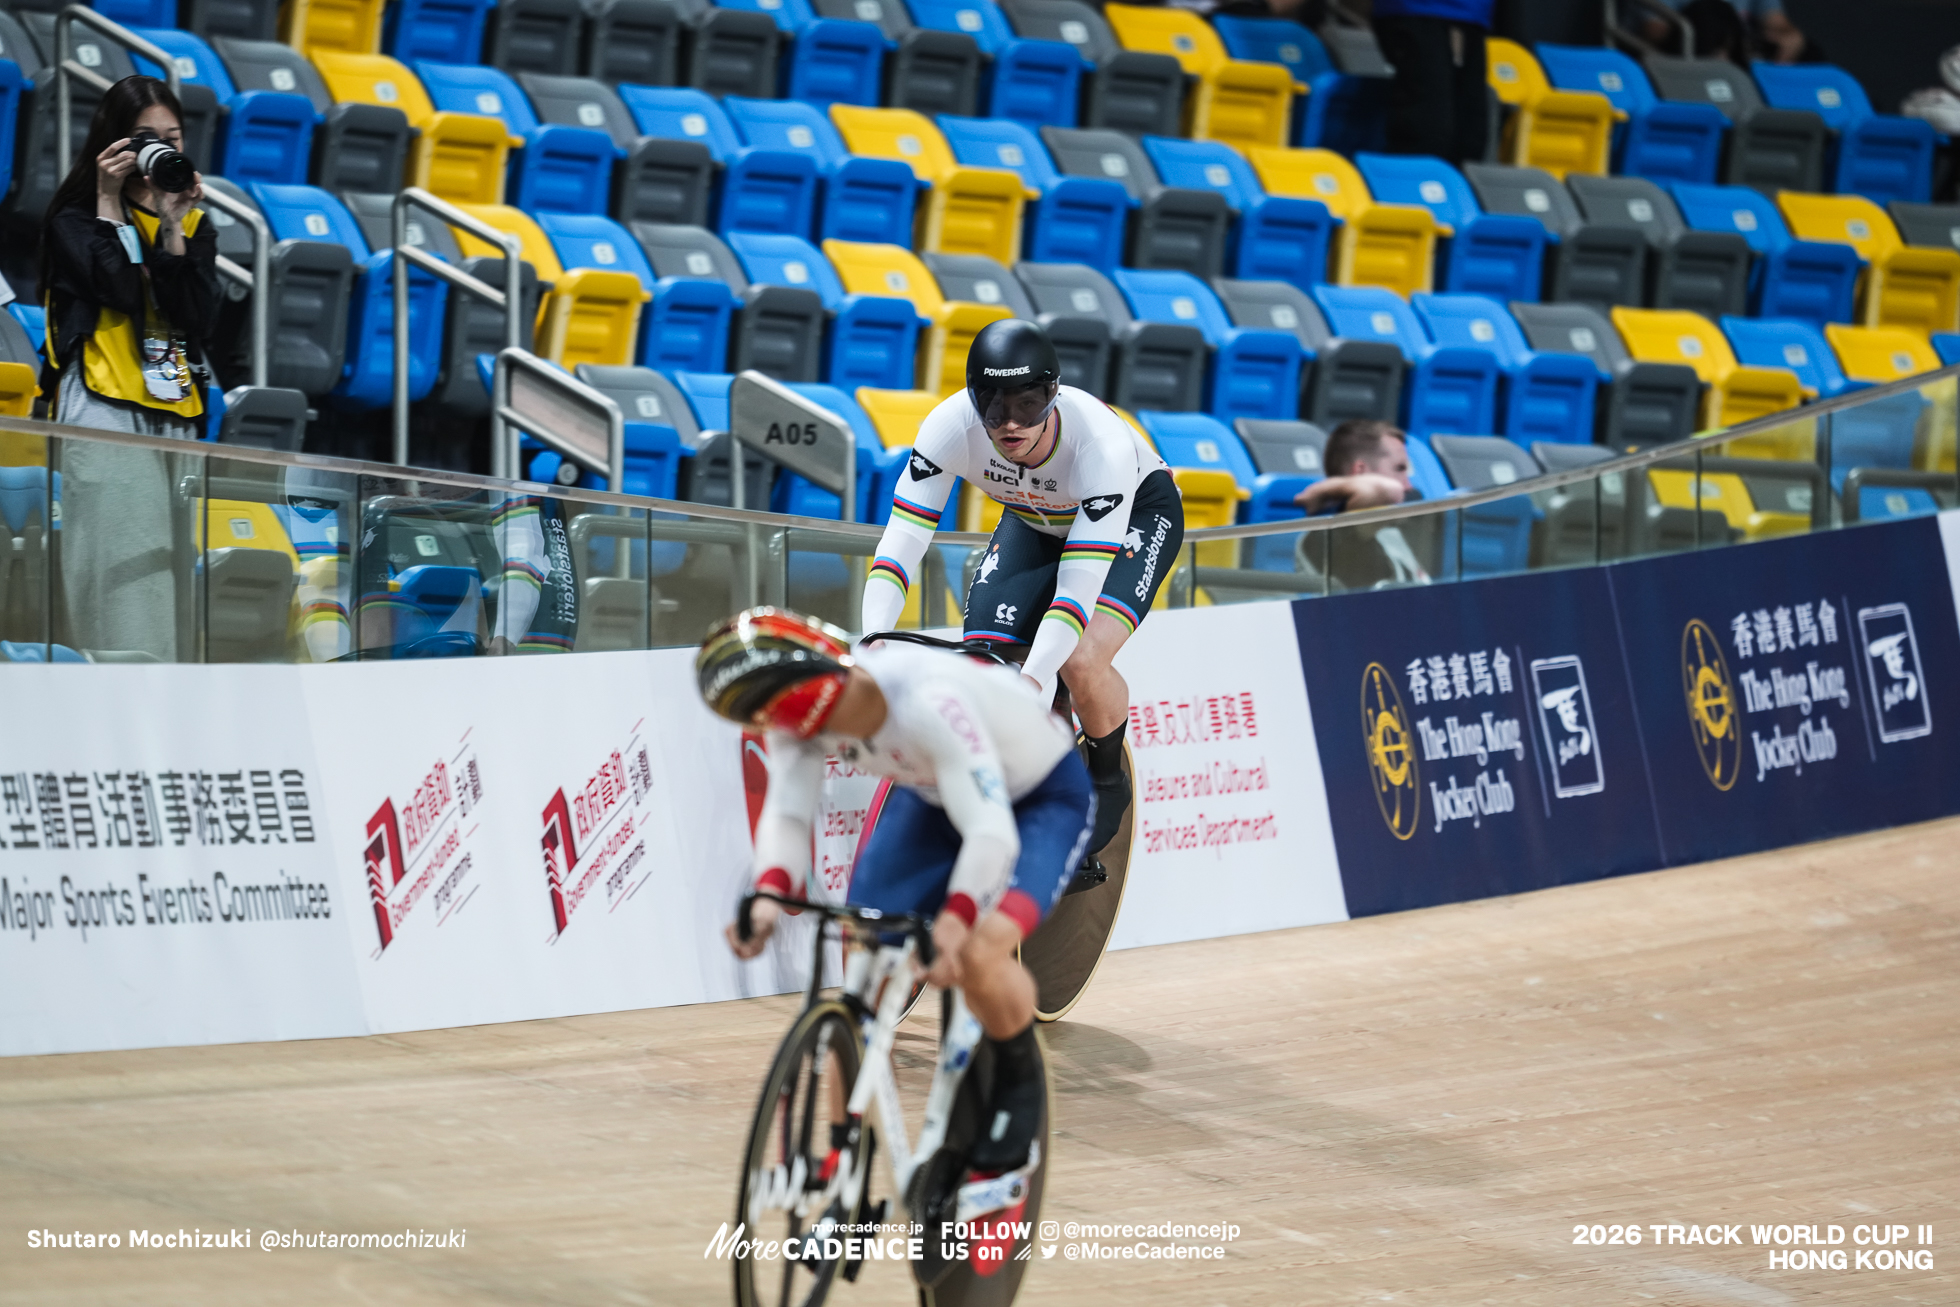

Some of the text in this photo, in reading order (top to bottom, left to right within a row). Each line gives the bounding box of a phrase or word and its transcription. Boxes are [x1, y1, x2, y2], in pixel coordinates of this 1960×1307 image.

[984, 365, 1031, 377] POWERADE
[765, 422, 818, 446] A05
[990, 471, 1020, 487] UCI
[1134, 513, 1173, 603] Staatsloterij
[1405, 647, 1514, 705] 香港賽馬會
[1416, 716, 1449, 761] The
[1798, 715, 1837, 763] Club
[0, 768, 315, 849] 型體育活動事務委員會
[1137, 769, 1188, 803] Leisure
[1475, 768, 1516, 815] Club
[0, 868, 331, 943] Major Sports Events Committee
